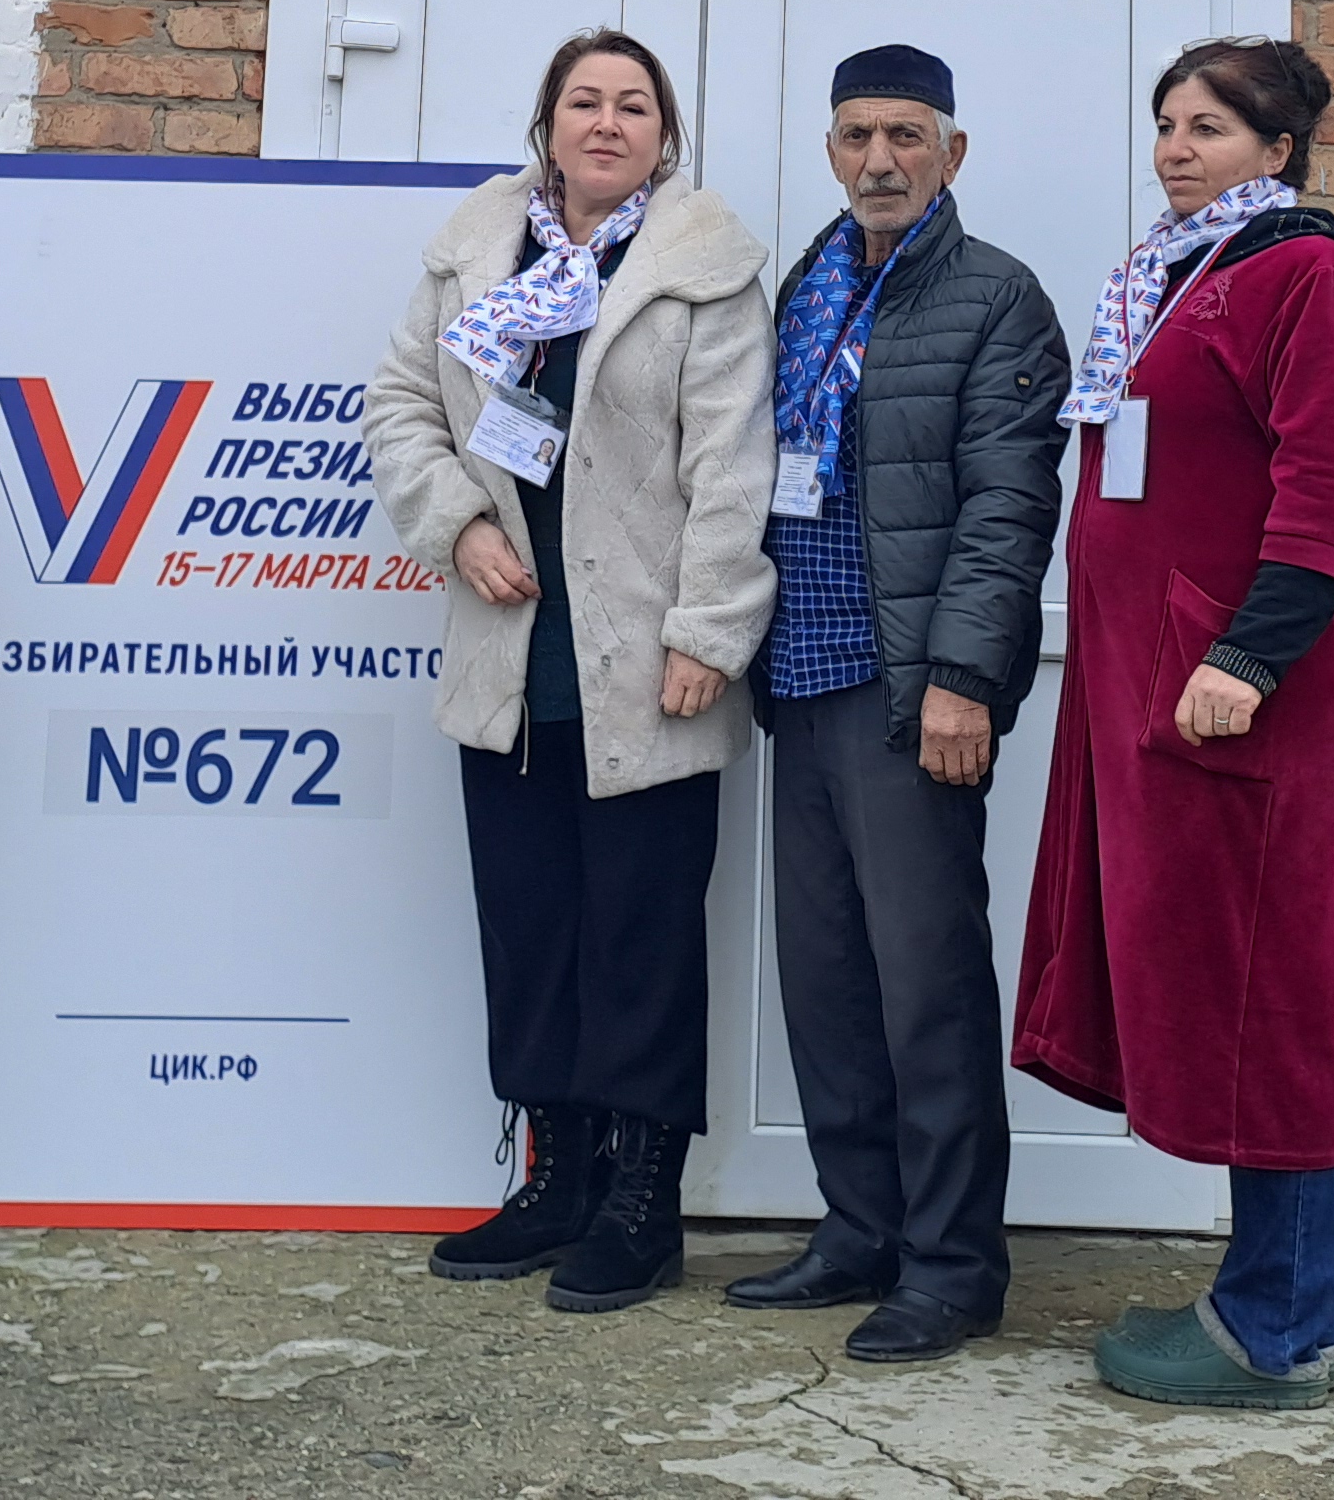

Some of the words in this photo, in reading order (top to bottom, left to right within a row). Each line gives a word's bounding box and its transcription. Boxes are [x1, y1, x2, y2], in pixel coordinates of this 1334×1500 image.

[232, 382, 368, 424] ВЫБО
[204, 438, 373, 488] ПРЕЗИ
[176, 495, 374, 539] РОССИИ
[253, 553, 371, 590] МАРТА
[311, 645, 443, 680] УЧАСТО
[85, 726, 342, 806] №672
[150, 1054, 258, 1086] ЦИК.РФ
